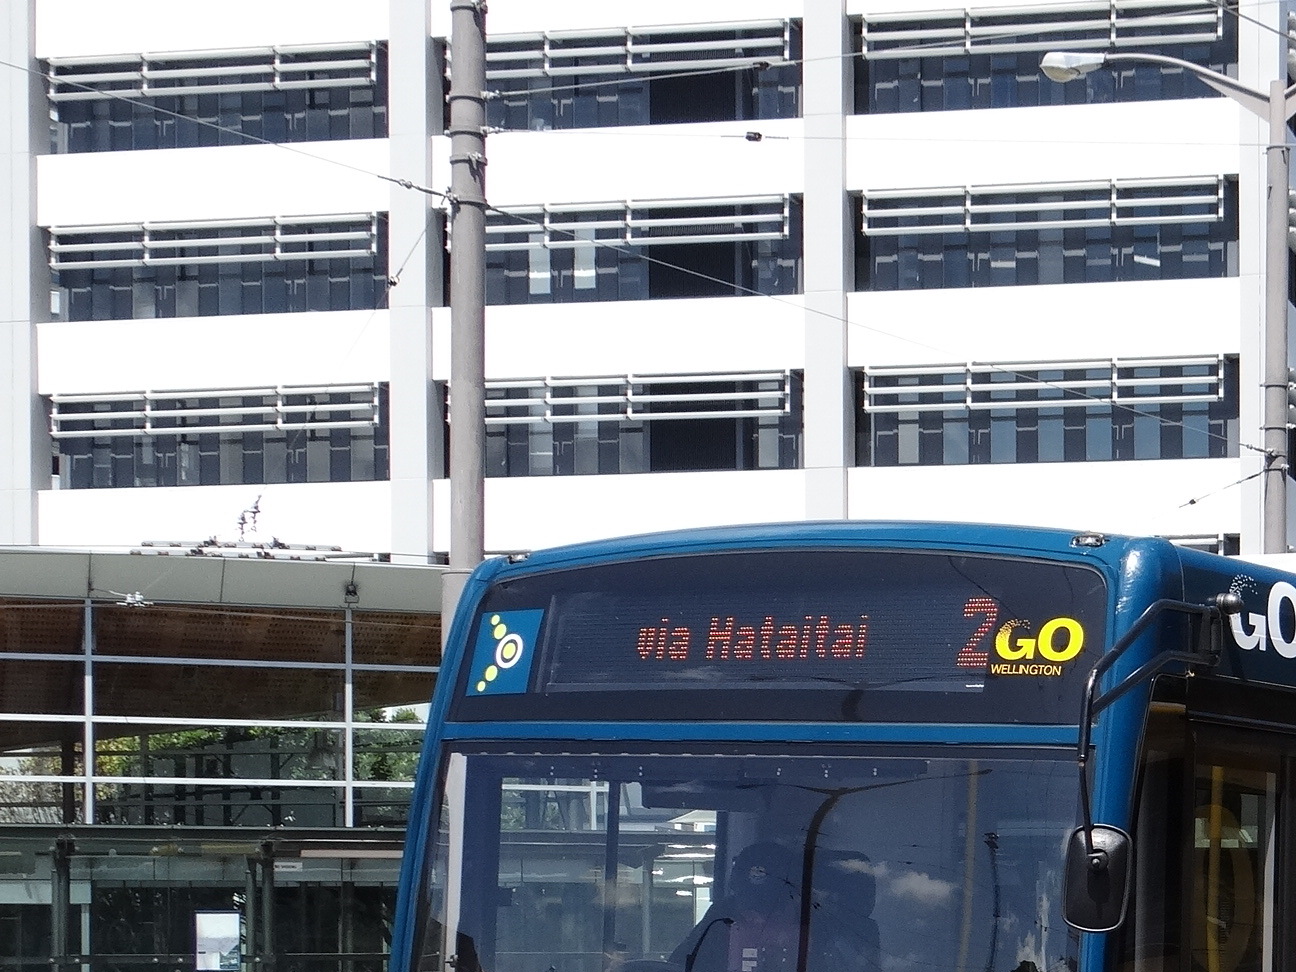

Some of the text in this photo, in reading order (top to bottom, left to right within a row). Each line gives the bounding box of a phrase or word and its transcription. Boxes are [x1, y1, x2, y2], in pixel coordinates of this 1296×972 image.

[637, 617, 690, 660] via
[705, 615, 869, 660] Hataitai
[995, 617, 1084, 662] GO
[990, 663, 1062, 677] WELLINGTON
